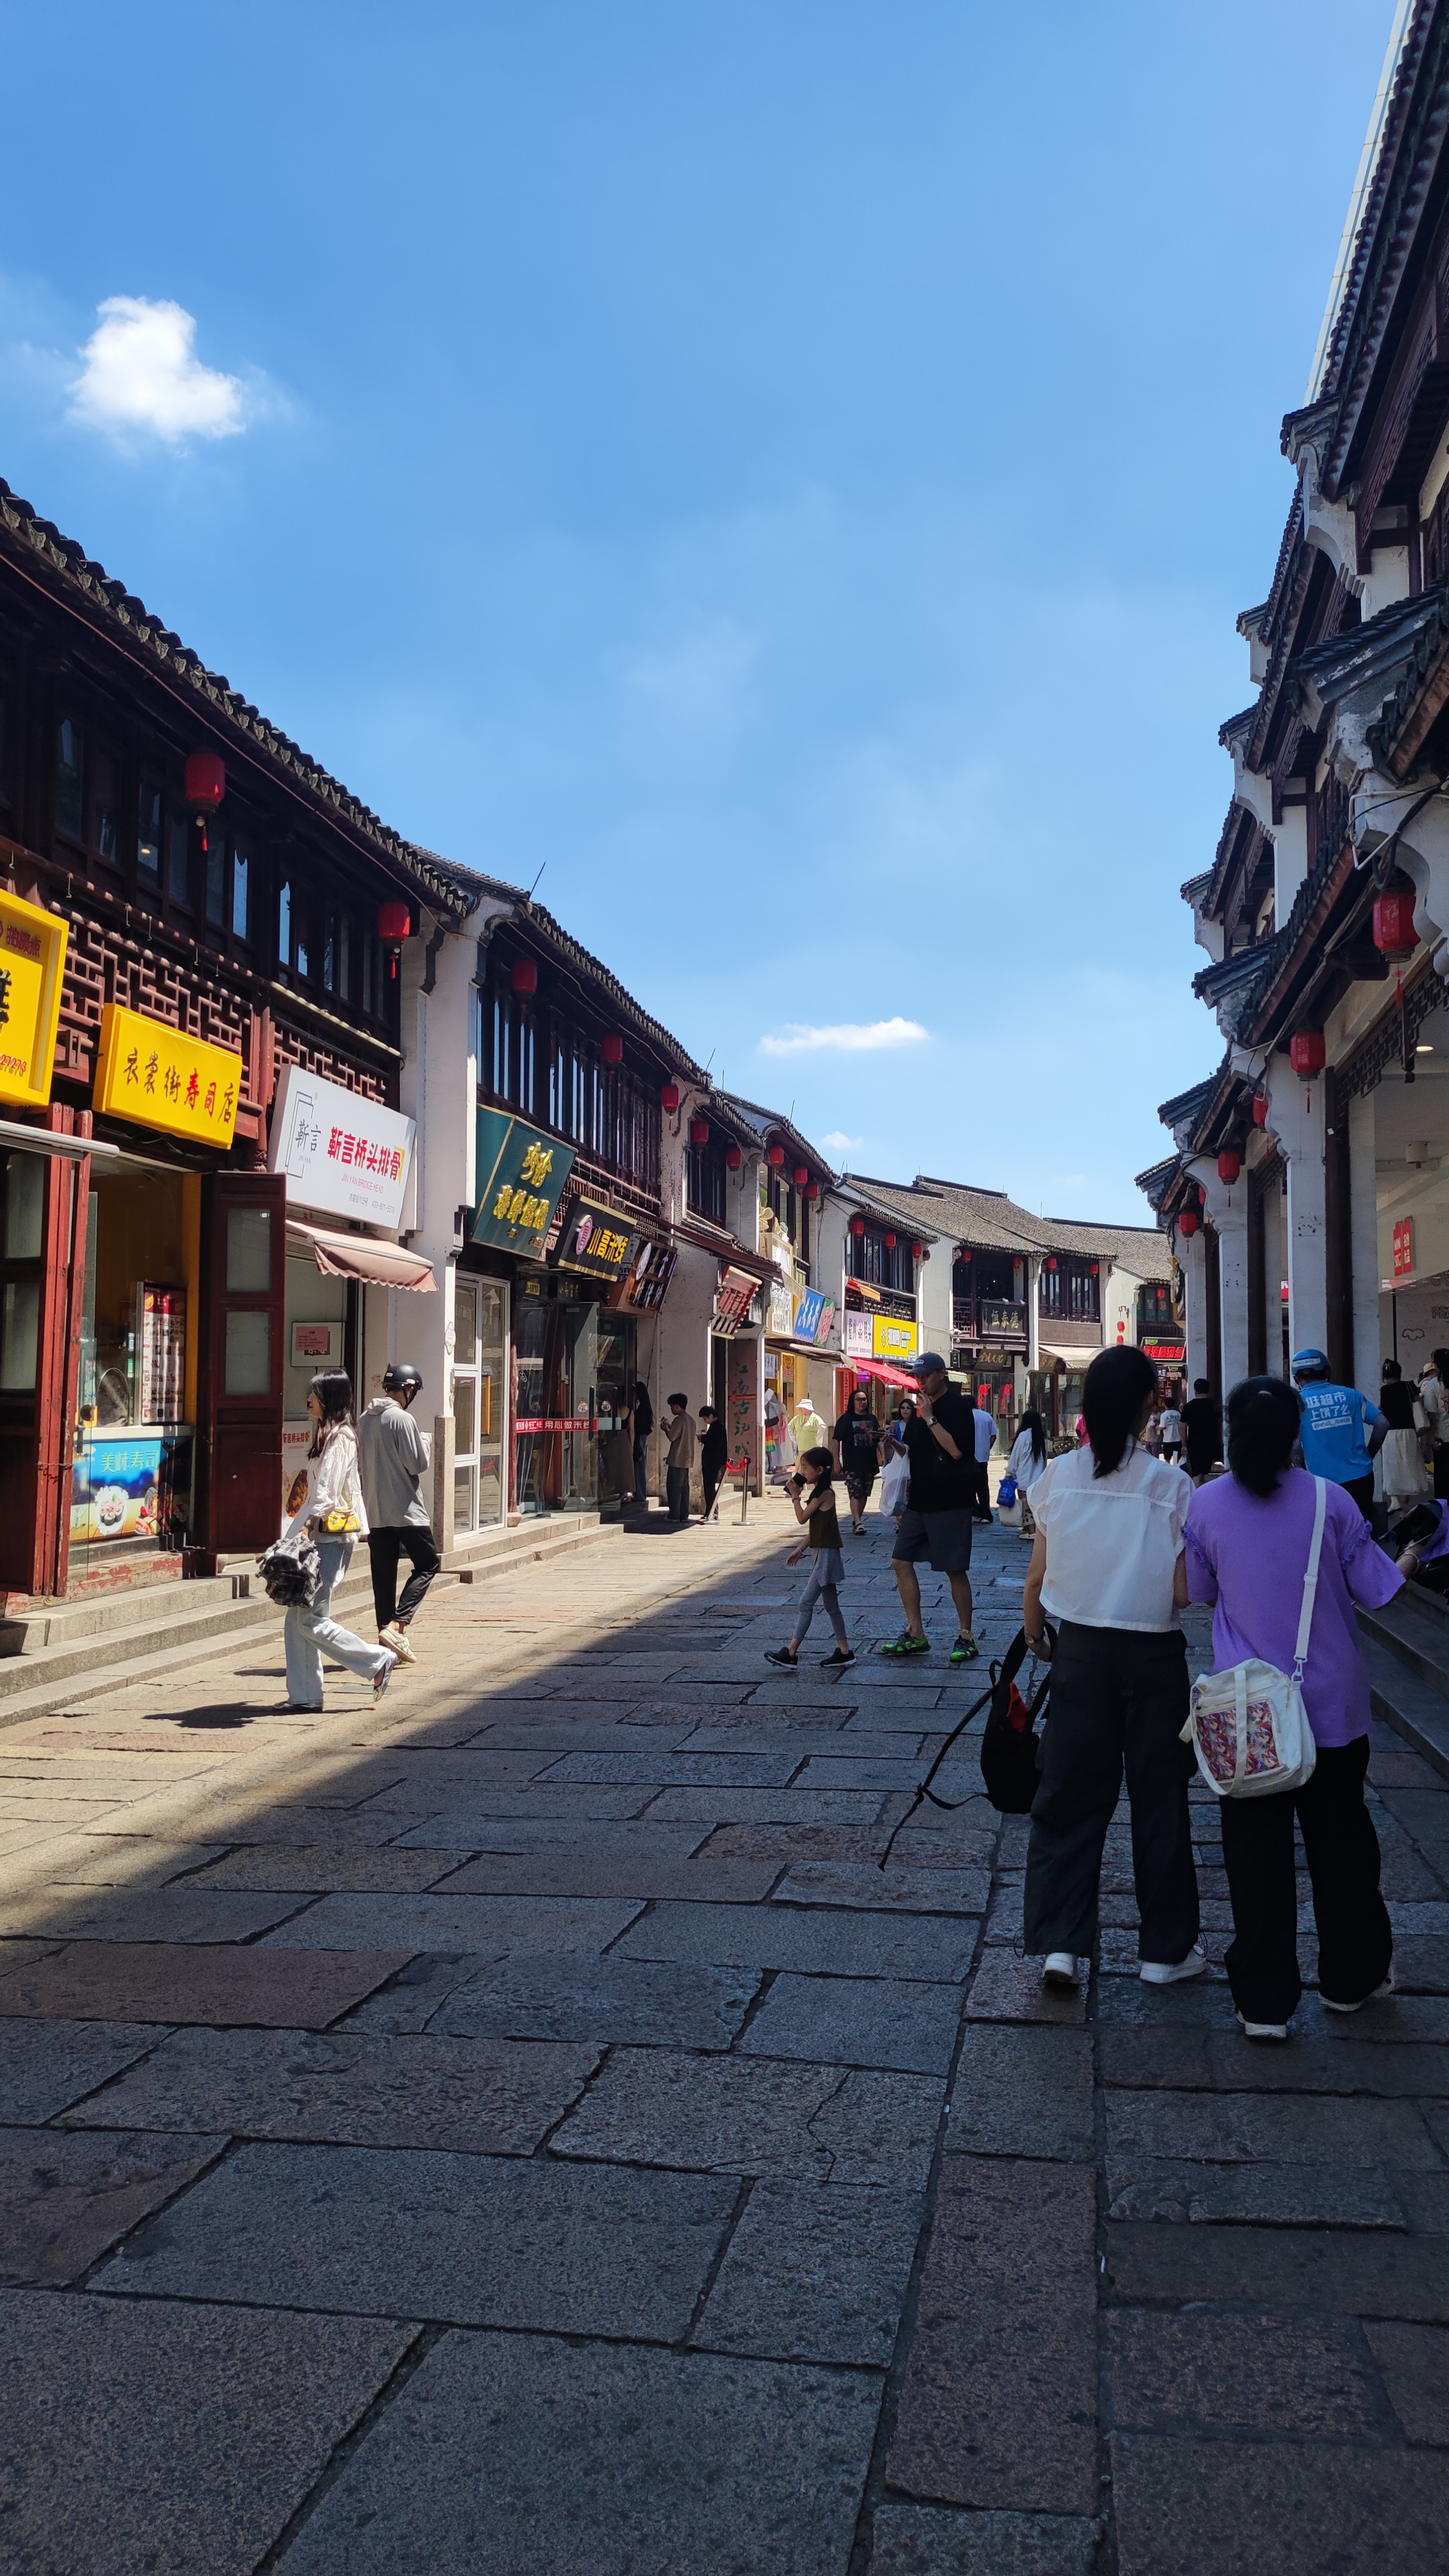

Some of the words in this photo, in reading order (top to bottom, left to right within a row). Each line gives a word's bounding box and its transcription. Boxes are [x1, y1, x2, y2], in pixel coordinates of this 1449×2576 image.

[328, 1126, 401, 1181] 靳言桥头排骨
[587, 1227, 628, 1264] 小高米线
[101, 1451, 159, 1474] 美味寿司
